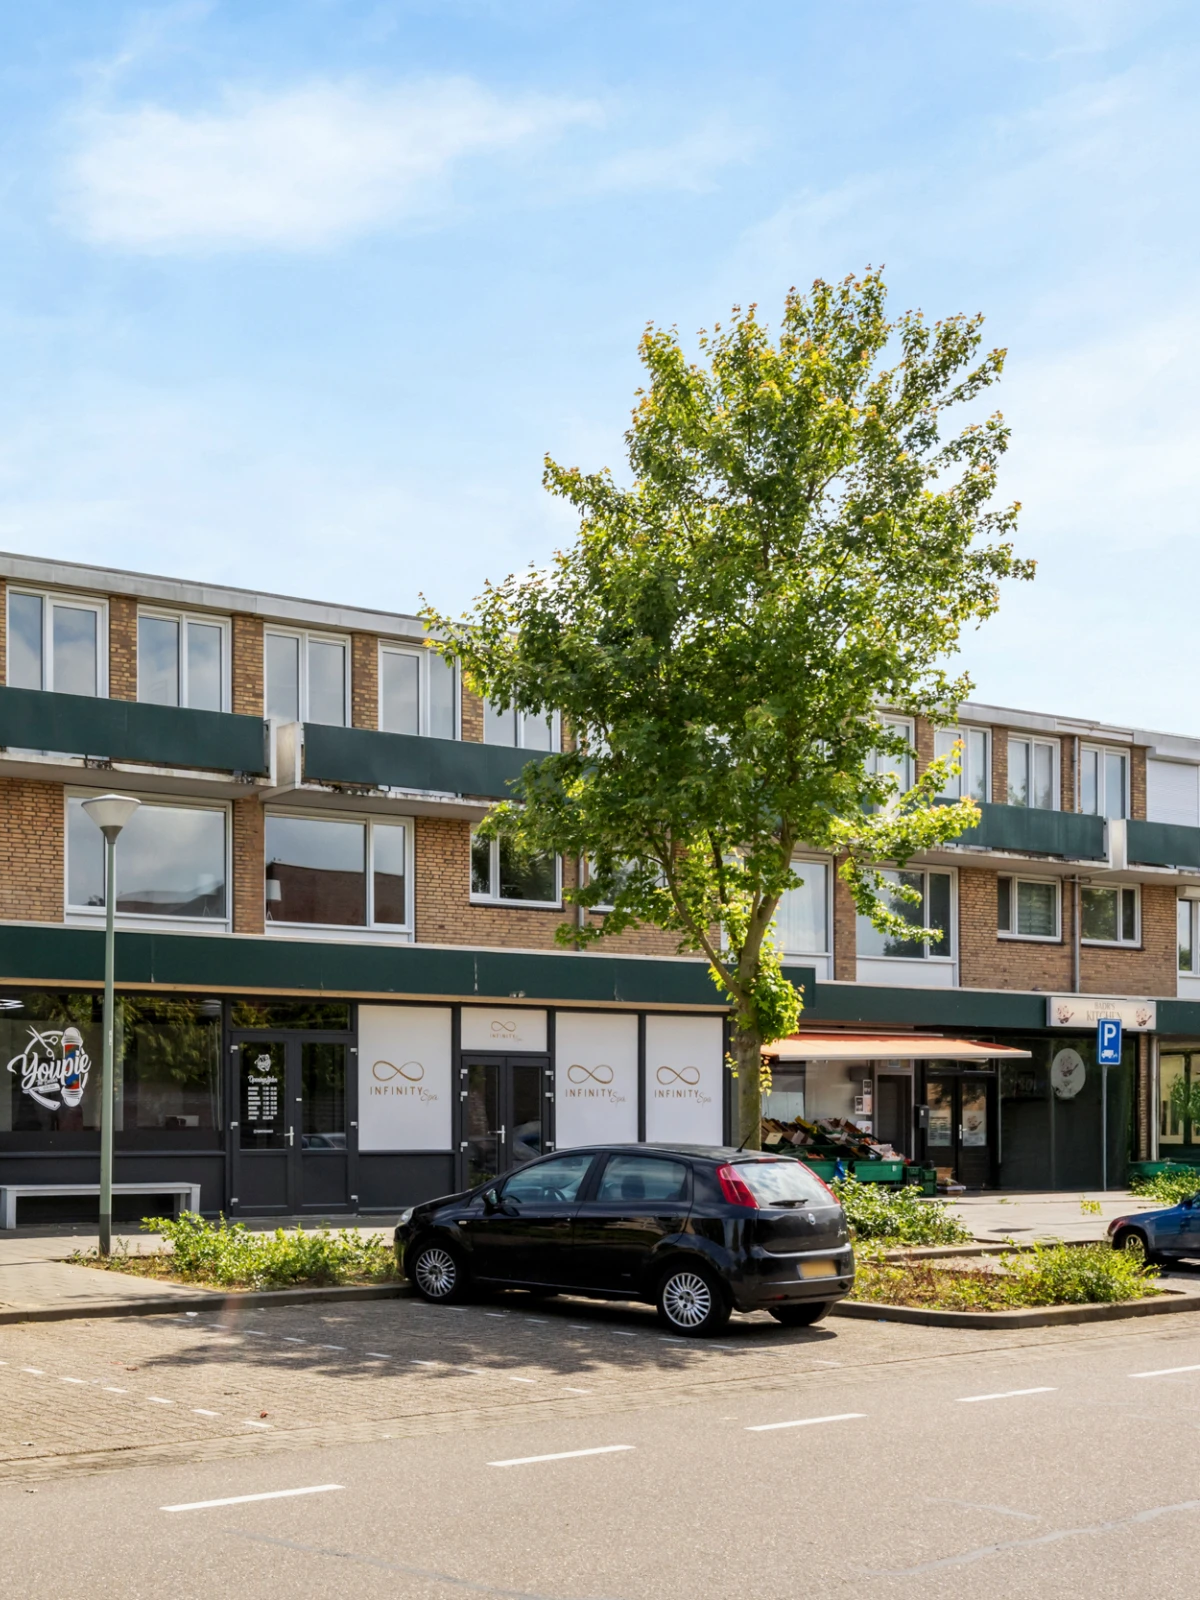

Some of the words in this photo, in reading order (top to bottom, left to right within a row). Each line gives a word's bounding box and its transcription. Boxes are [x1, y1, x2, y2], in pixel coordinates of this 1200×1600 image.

[1104, 1023, 1117, 1046] P
[7, 1050, 92, 1090] Youpie
[370, 1086, 423, 1096] INFINITY
[565, 1088, 613, 1098] INFINITY
[654, 1089, 699, 1098] INFINITY
